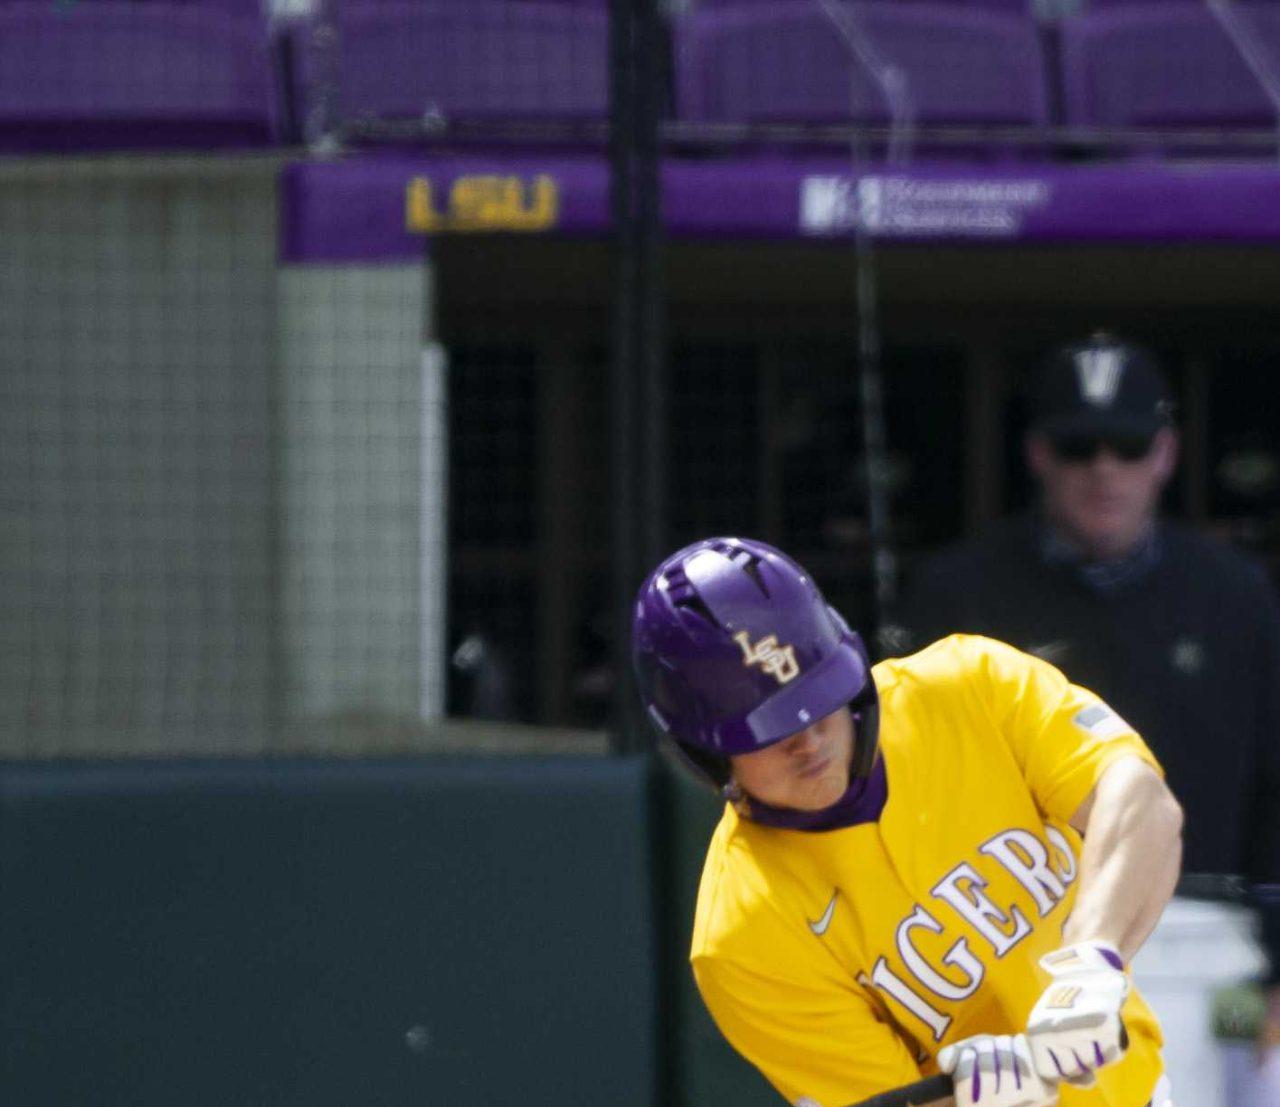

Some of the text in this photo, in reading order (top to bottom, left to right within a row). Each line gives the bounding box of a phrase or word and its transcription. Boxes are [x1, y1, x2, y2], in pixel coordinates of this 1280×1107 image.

[407, 176, 556, 232] LSU
[734, 630, 800, 684] LSU
[856, 826, 1078, 1044] IGERS
